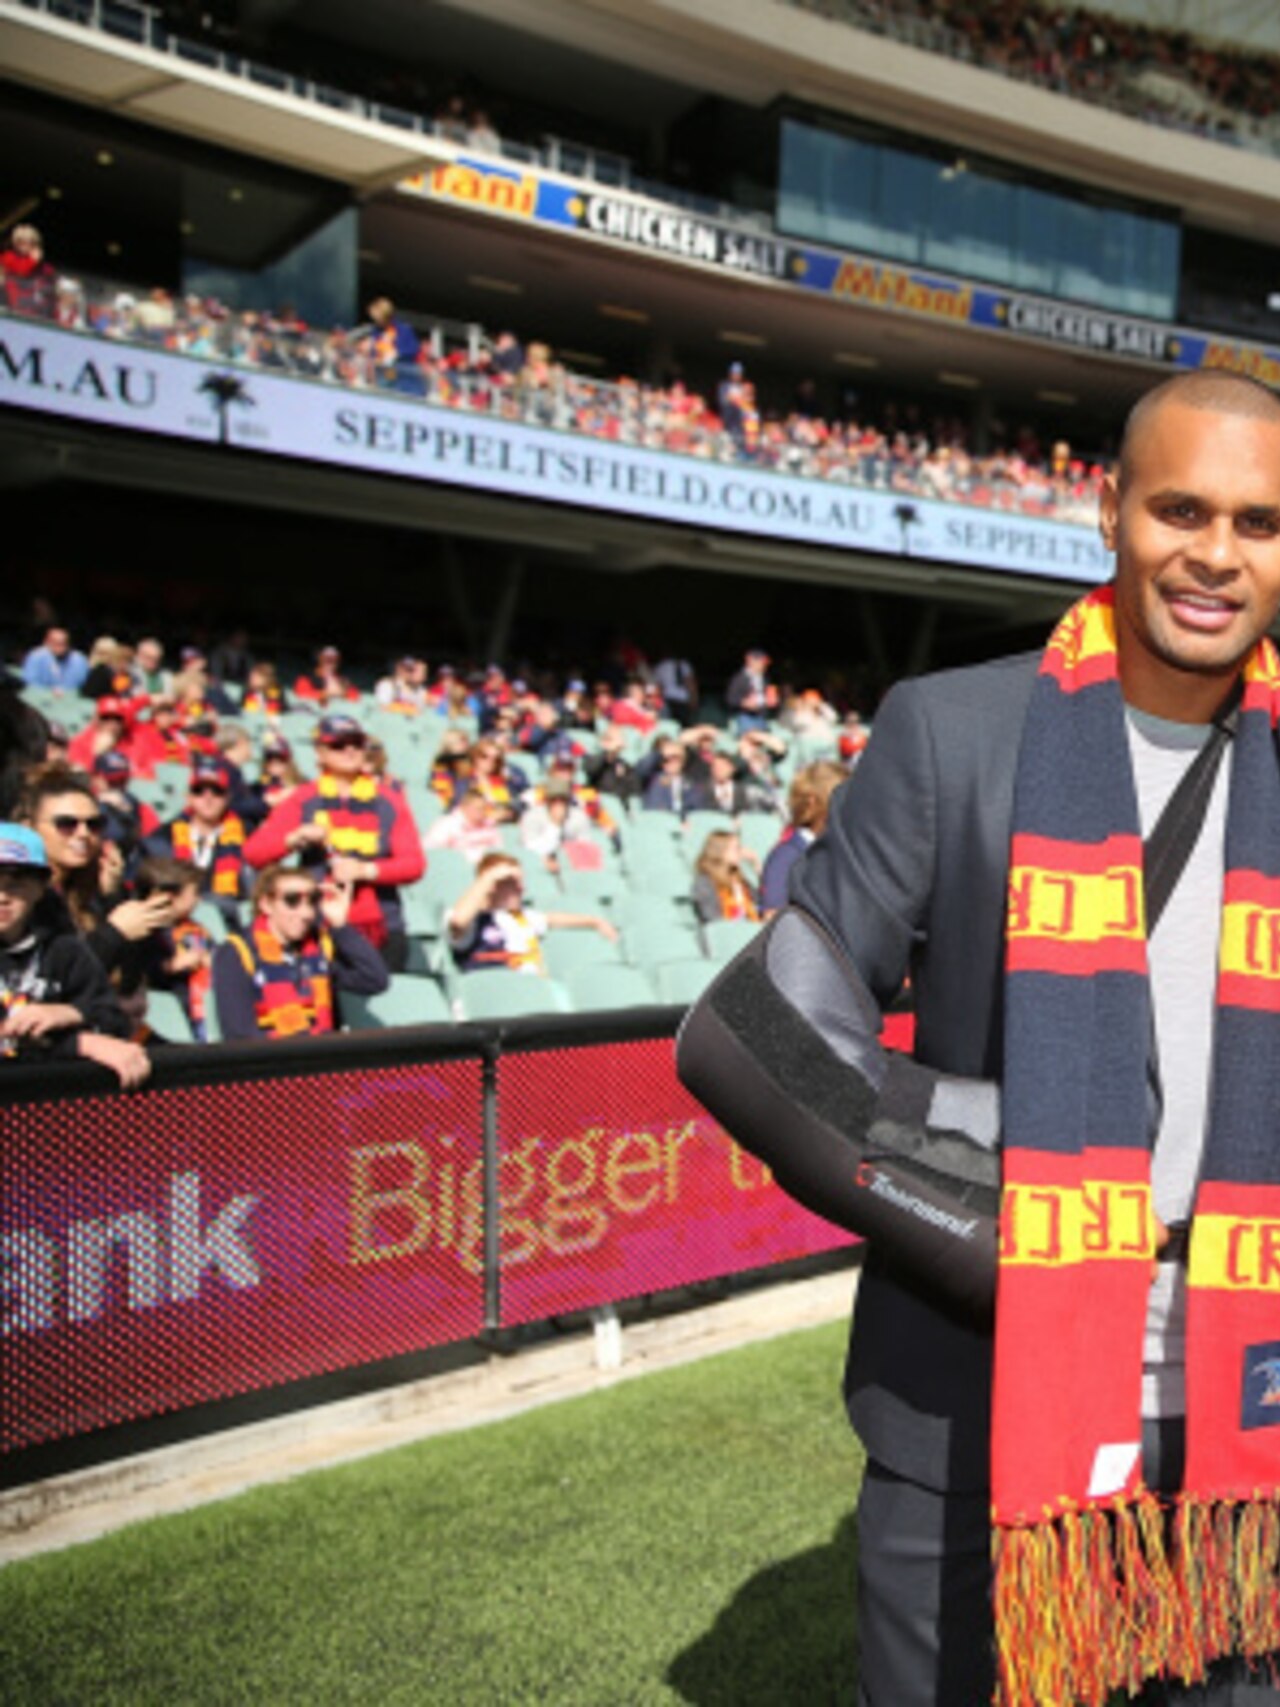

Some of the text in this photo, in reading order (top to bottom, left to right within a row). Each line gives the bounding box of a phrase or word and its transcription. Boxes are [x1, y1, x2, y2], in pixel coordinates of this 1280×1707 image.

[586, 193, 788, 277] CHICKEN SALT
[835, 257, 970, 321] Mitani
[1007, 298, 1166, 358] CHICKEN SALT
[334, 408, 876, 533] SEPPELTSFIELD.COM.AU
[348, 1117, 698, 1275] Bigger
